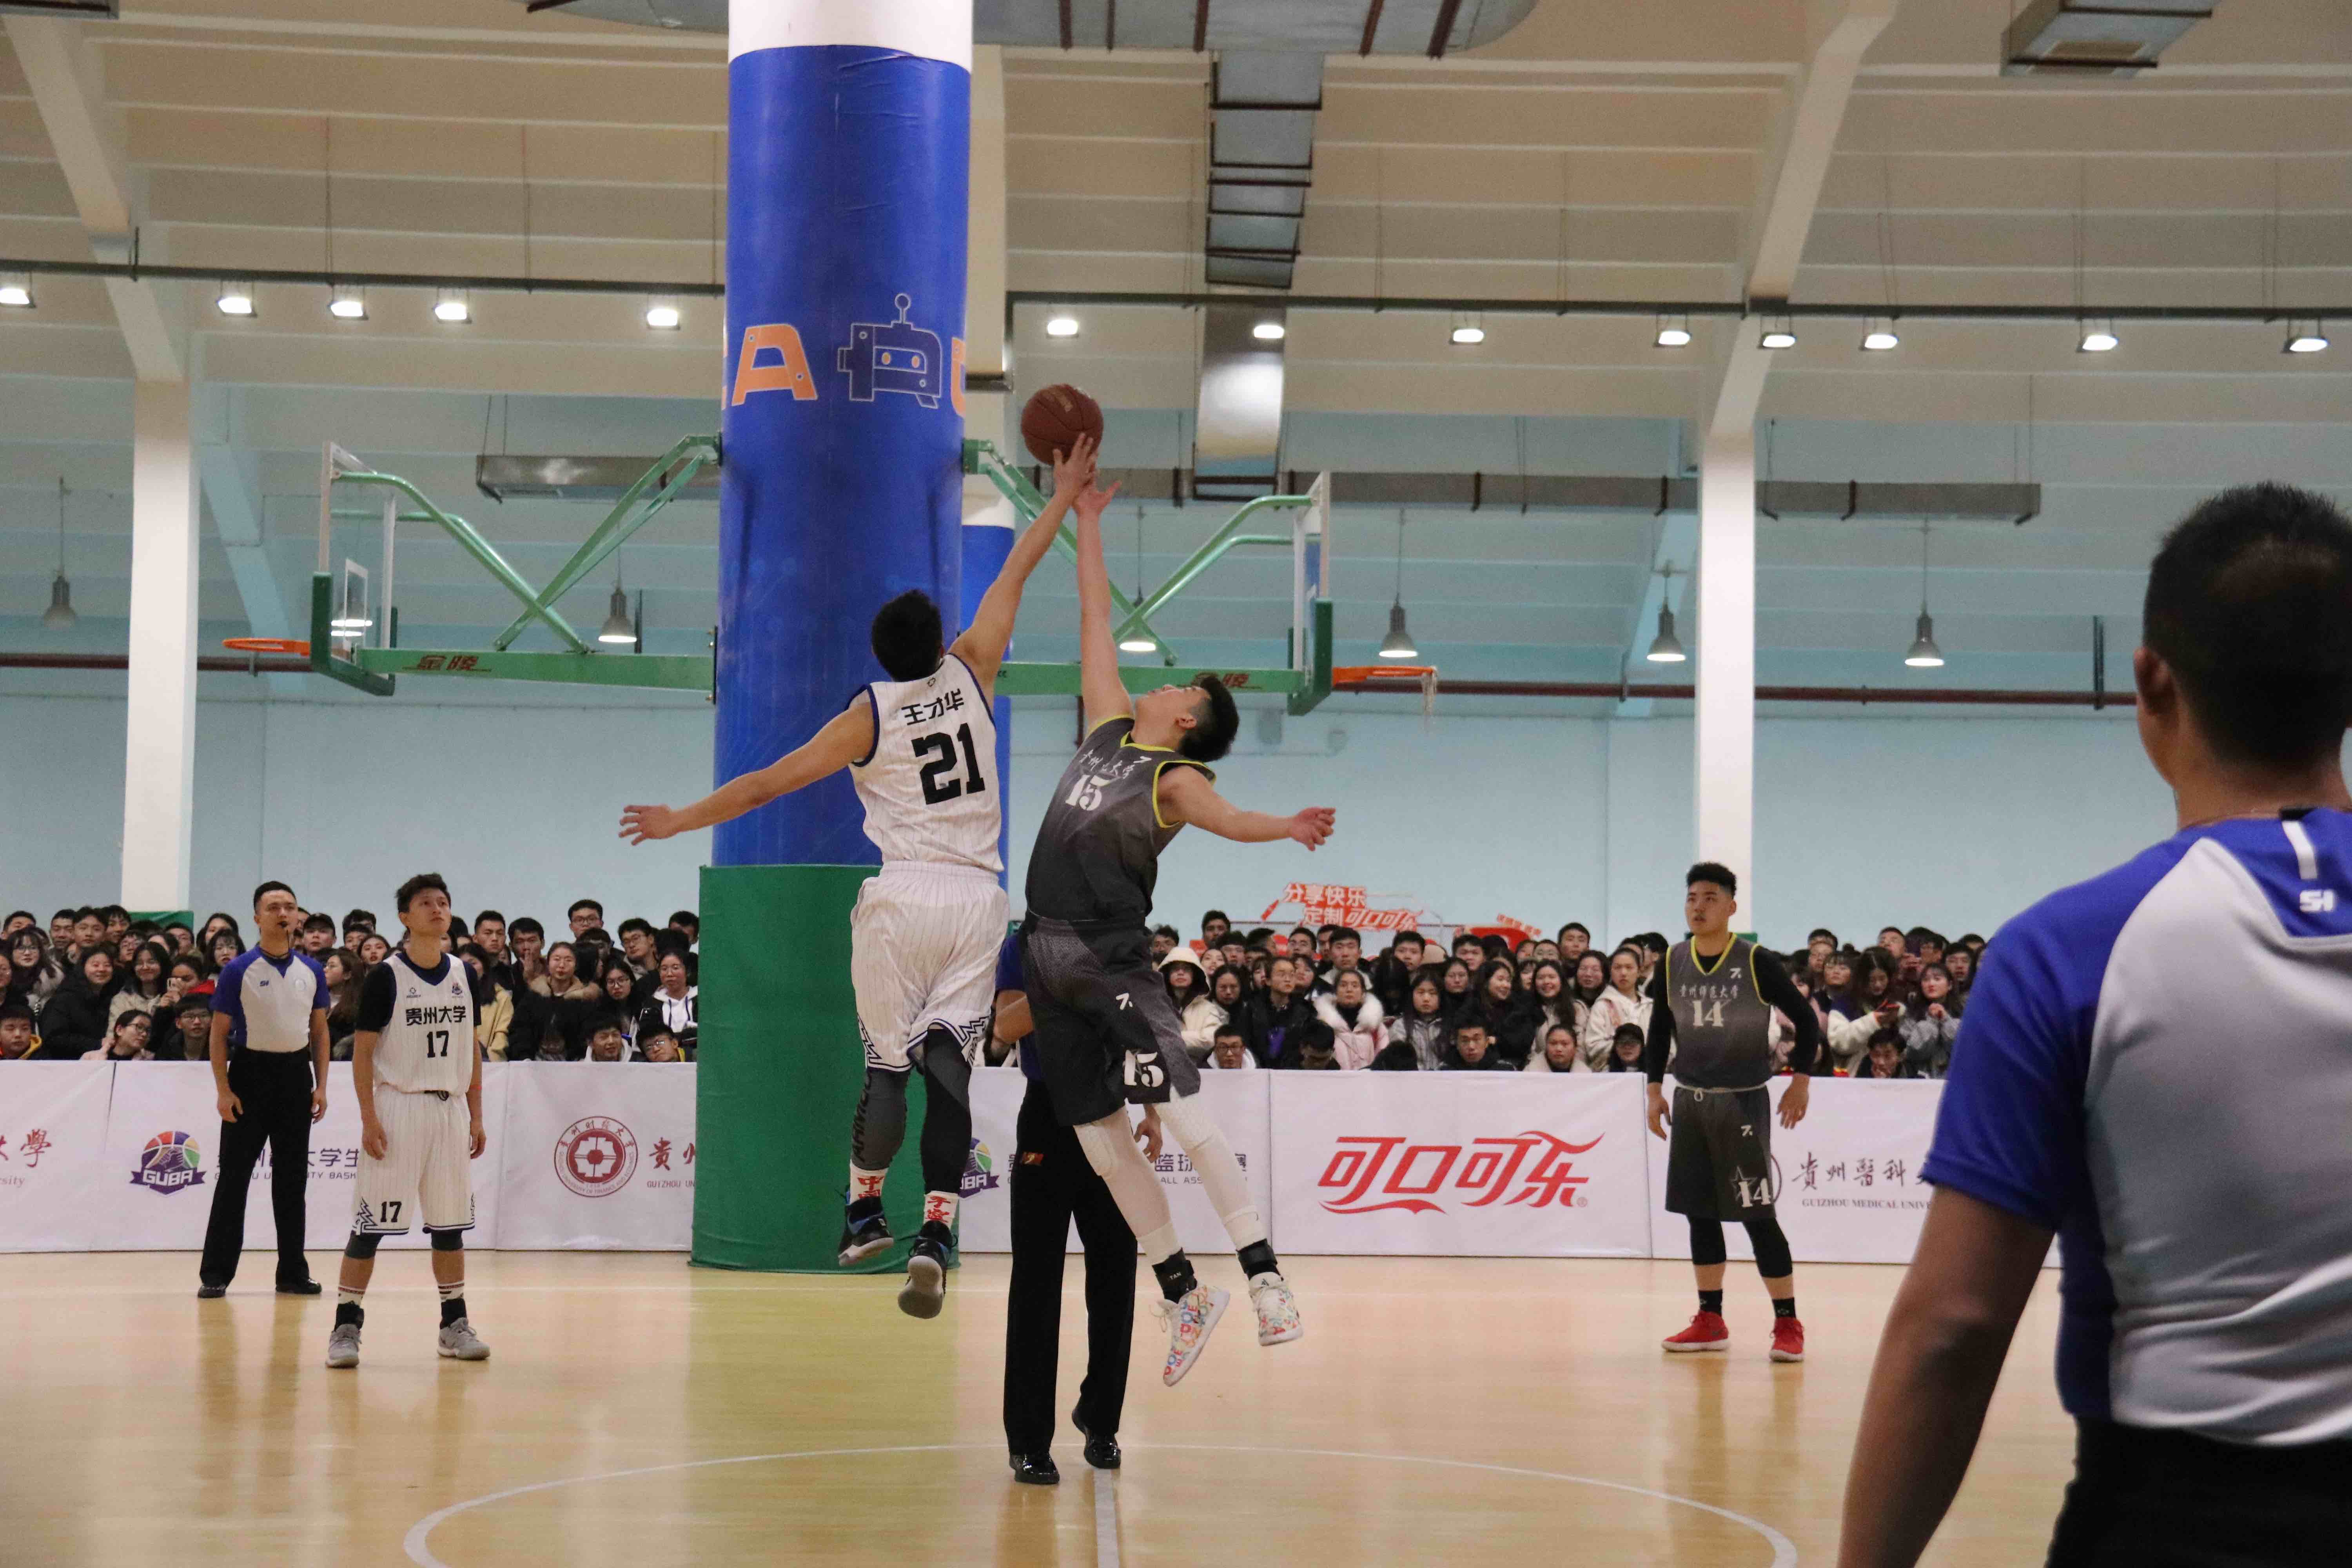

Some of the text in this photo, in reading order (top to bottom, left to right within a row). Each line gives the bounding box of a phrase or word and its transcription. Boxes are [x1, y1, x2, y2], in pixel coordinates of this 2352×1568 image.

[901, 688, 964, 726] 王才华
[911, 722, 985, 805] 21
[1065, 774, 1111, 811] 15
[1283, 883, 1368, 909] 分享快乐
[405, 1005, 466, 1026] 贵州大学
[1692, 1000, 1724, 1027] 14
[426, 1031, 449, 1058] 17
[1123, 1049, 1164, 1087] 15
[142, 1169, 194, 1187] GUBA
[647, 1180, 681, 1188] GUIZHOU
[1317, 1131, 1606, 1214] 可口可乐
[1738, 1178, 1771, 1208] 14
[1802, 1198, 1850, 1208] GUIZHOU
[1852, 1199, 1897, 1209] MEDICAL
[380, 1201, 402, 1223] 17
